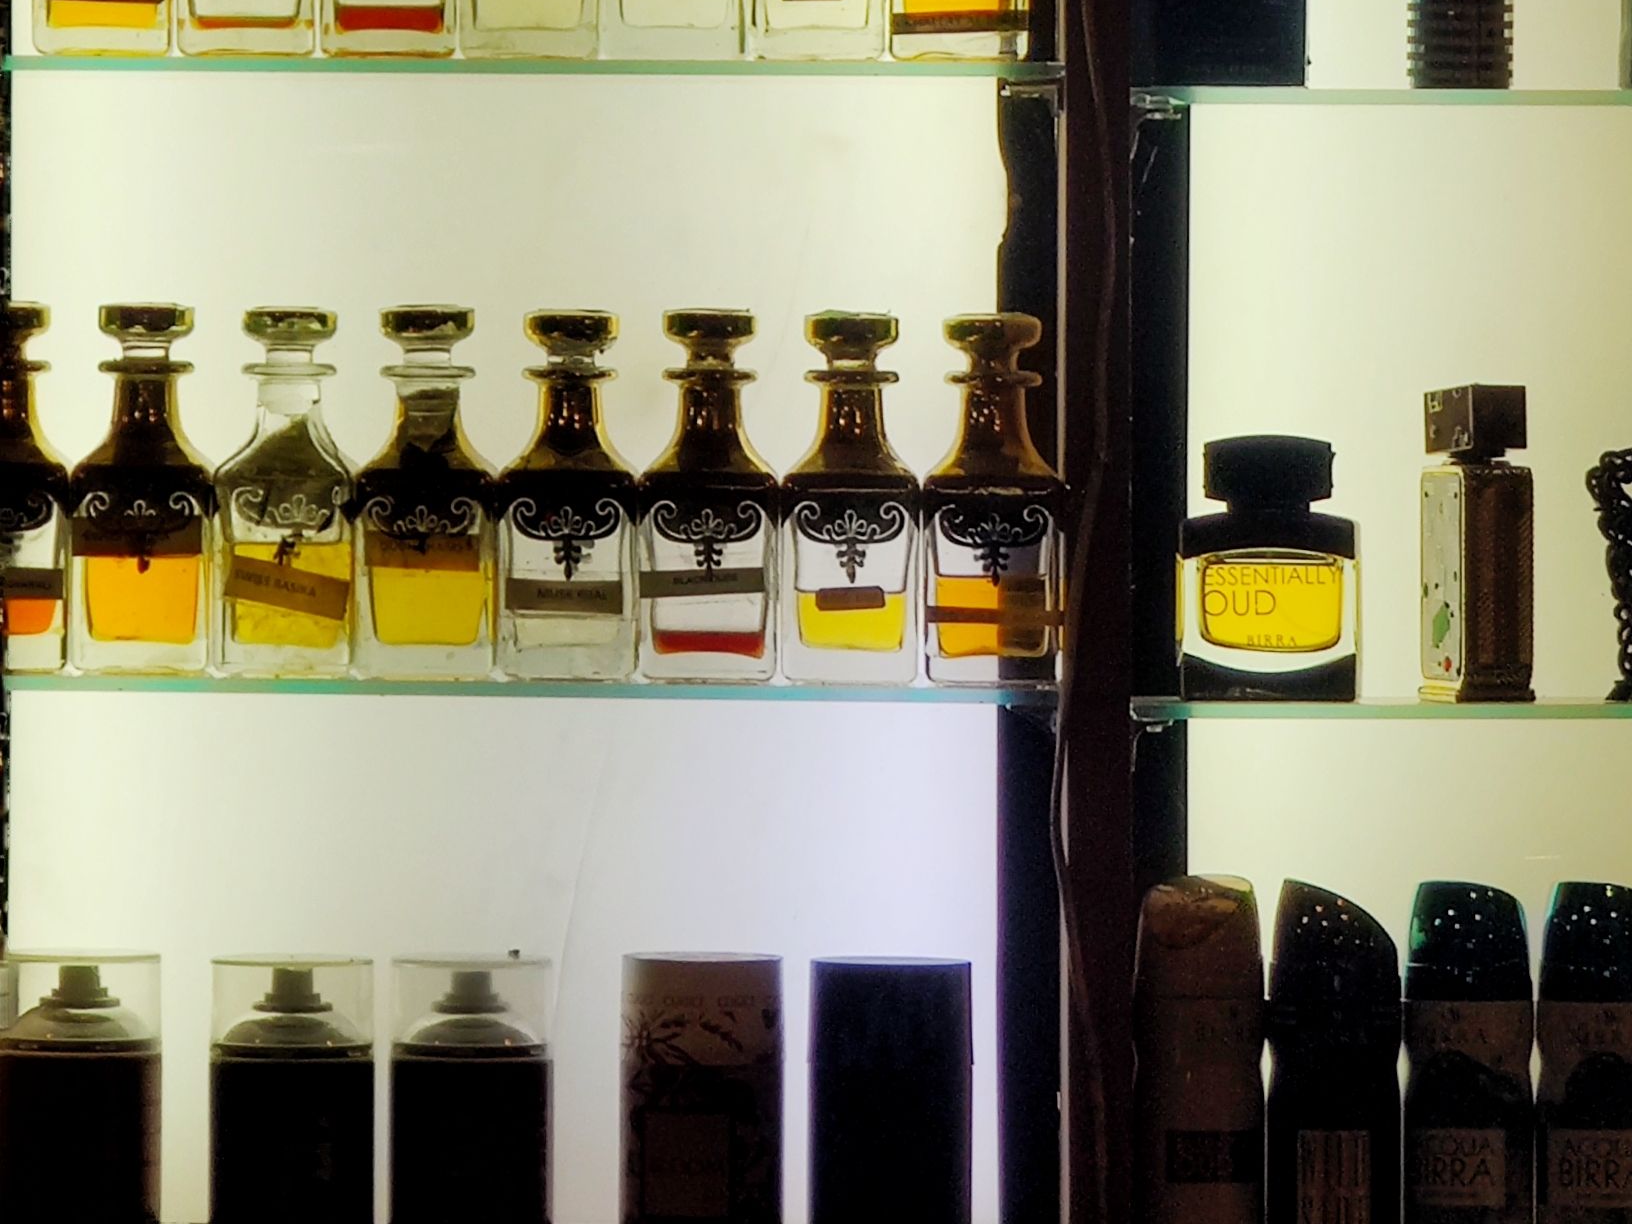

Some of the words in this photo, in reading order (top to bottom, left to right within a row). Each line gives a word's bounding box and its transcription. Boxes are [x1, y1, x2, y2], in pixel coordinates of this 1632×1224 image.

[1203, 565, 1343, 586] ESSENTIALLY
[1203, 590, 1276, 616] OUD
[1245, 634, 1298, 648] BIRRA
